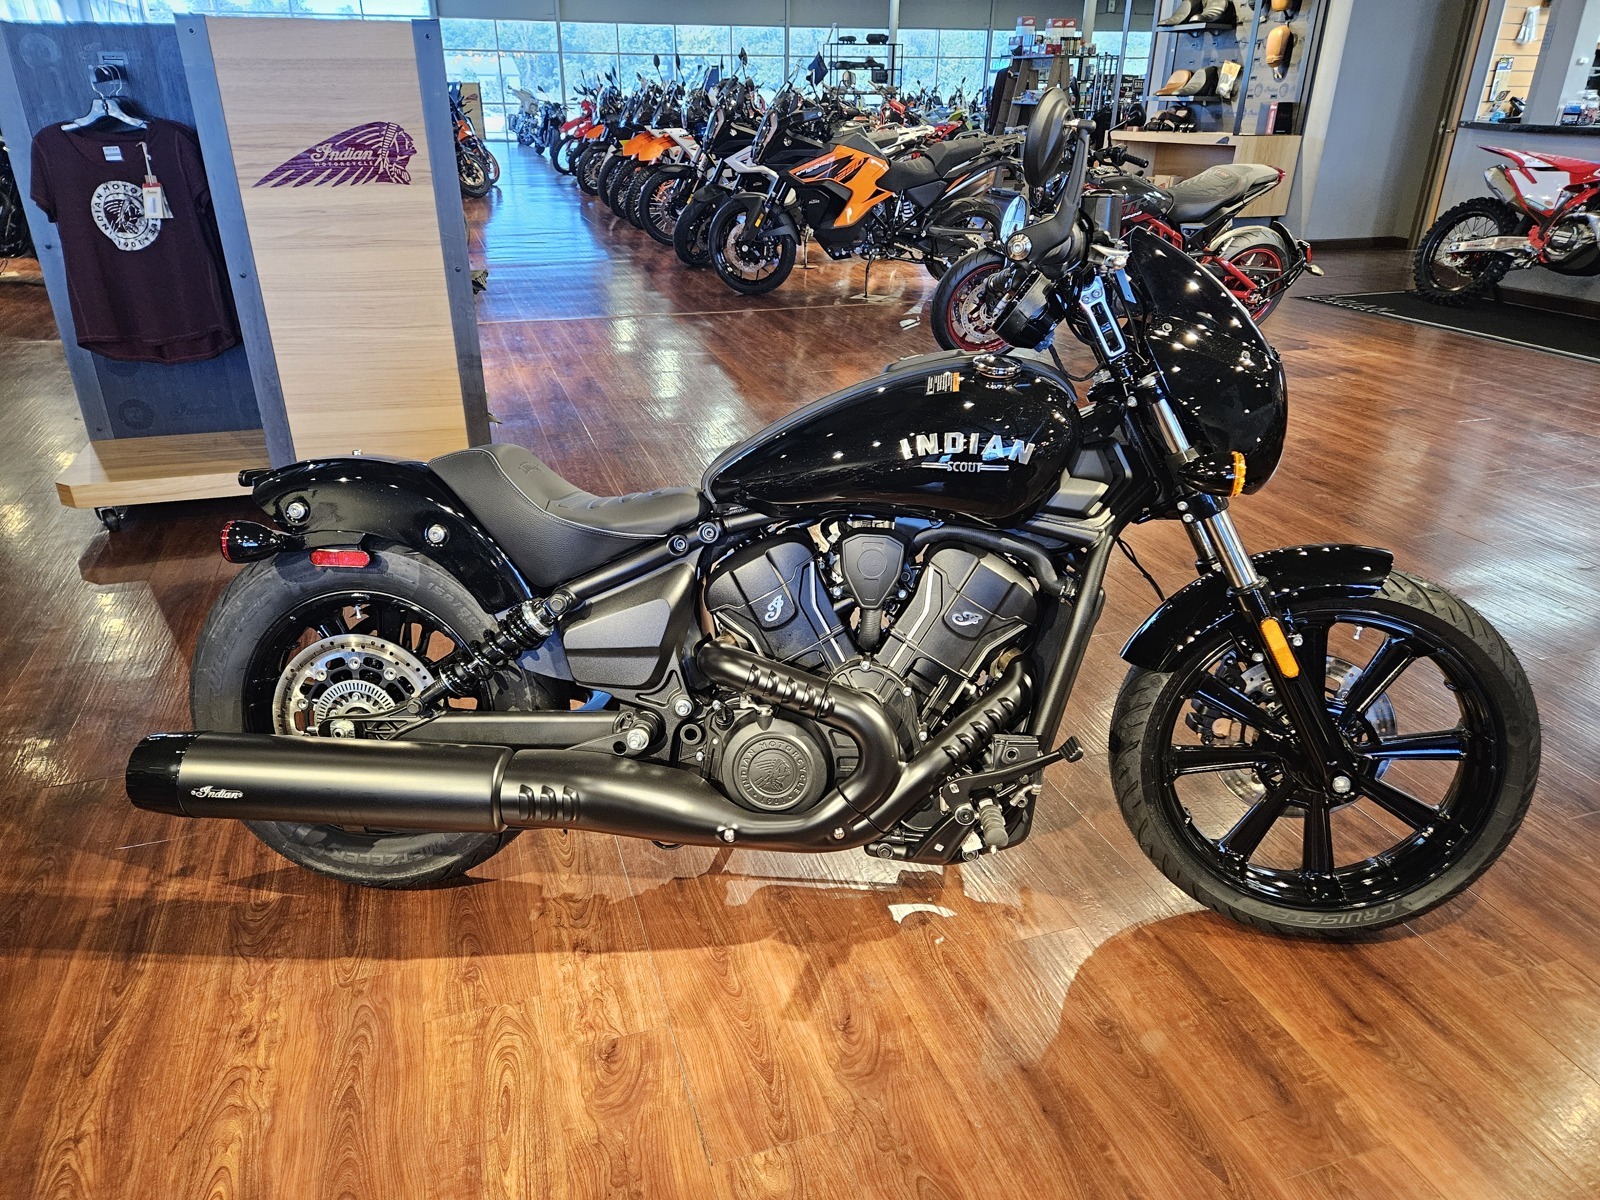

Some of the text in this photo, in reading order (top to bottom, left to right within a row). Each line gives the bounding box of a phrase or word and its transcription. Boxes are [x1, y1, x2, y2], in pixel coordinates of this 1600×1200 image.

[310, 143, 374, 162] Indian
[900, 432, 1036, 465] INDIAN
[946, 461, 984, 473] SCOUT
[740, 740, 808, 795] INDIAN MOTORCYCLE
[194, 785, 240, 799] Indian
[331, 841, 444, 867] METZELER
